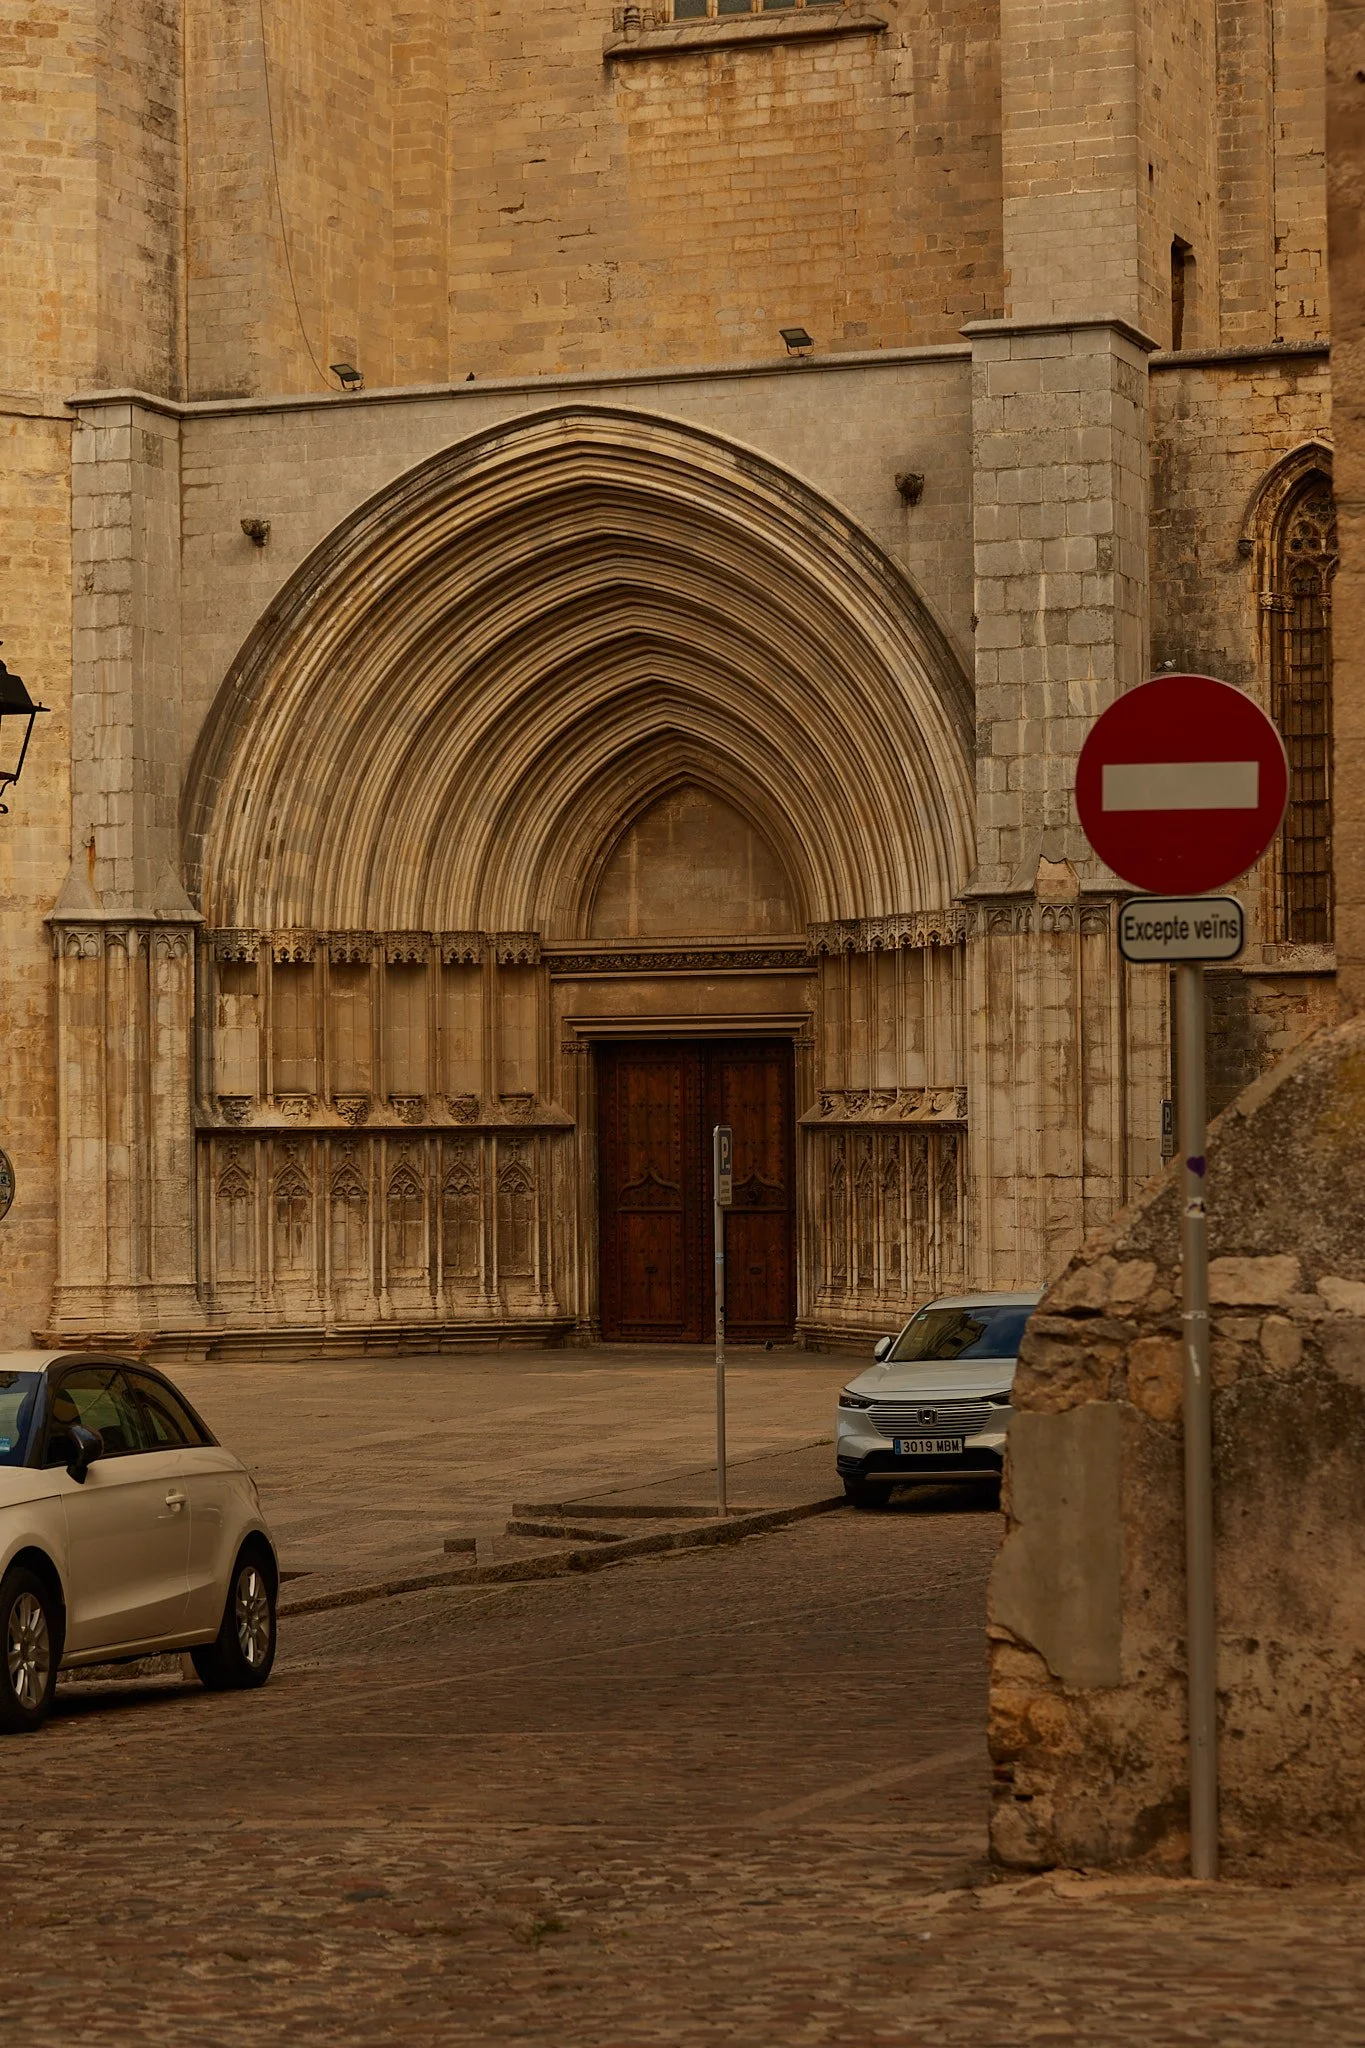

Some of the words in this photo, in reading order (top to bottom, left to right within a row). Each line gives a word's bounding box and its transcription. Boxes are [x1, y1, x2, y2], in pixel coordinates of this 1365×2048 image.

[1124, 915, 1190, 946] Excepte
[1193, 913, 1239, 940] veïns
[721, 1136, 729, 1169] P
[903, 1441, 933, 1453] 3019
[936, 1440, 960, 1452] MBM
